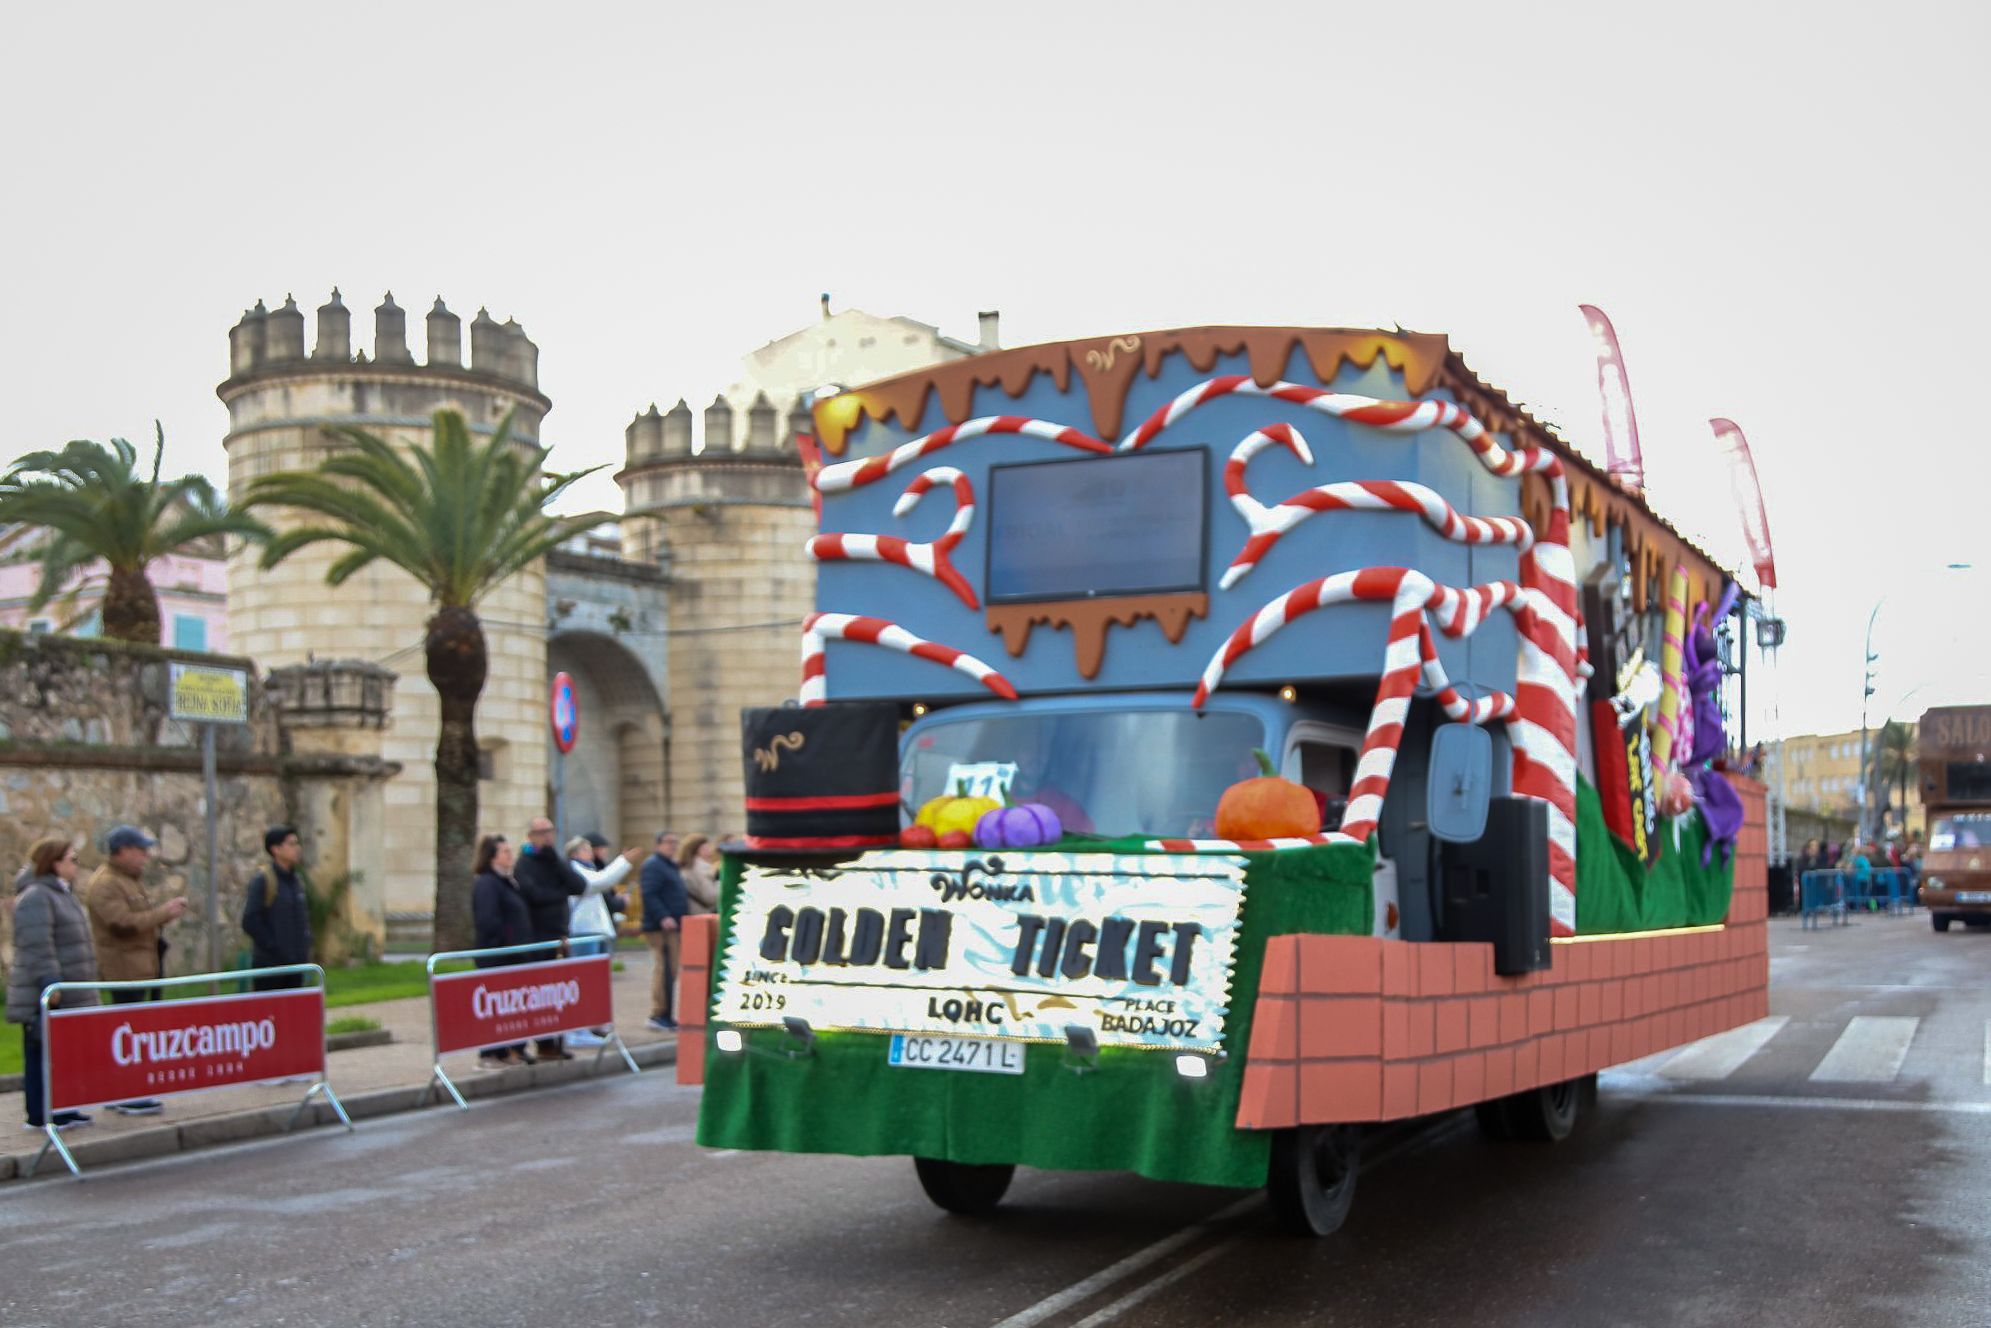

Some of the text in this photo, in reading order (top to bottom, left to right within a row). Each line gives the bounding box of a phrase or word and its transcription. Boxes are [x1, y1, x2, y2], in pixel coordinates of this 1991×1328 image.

[759, 904, 1202, 986] GOLDEN TICKET
[472, 980, 580, 1020] Cruzcampo
[740, 991, 786, 1010] 2019
[1125, 999, 1176, 1013] PLACE
[1101, 1013, 1200, 1038] BADAJOZ
[111, 1020, 276, 1066] Cruzcampo
[906, 1037, 933, 1062] CC
[938, 1039, 993, 1066] 2471
